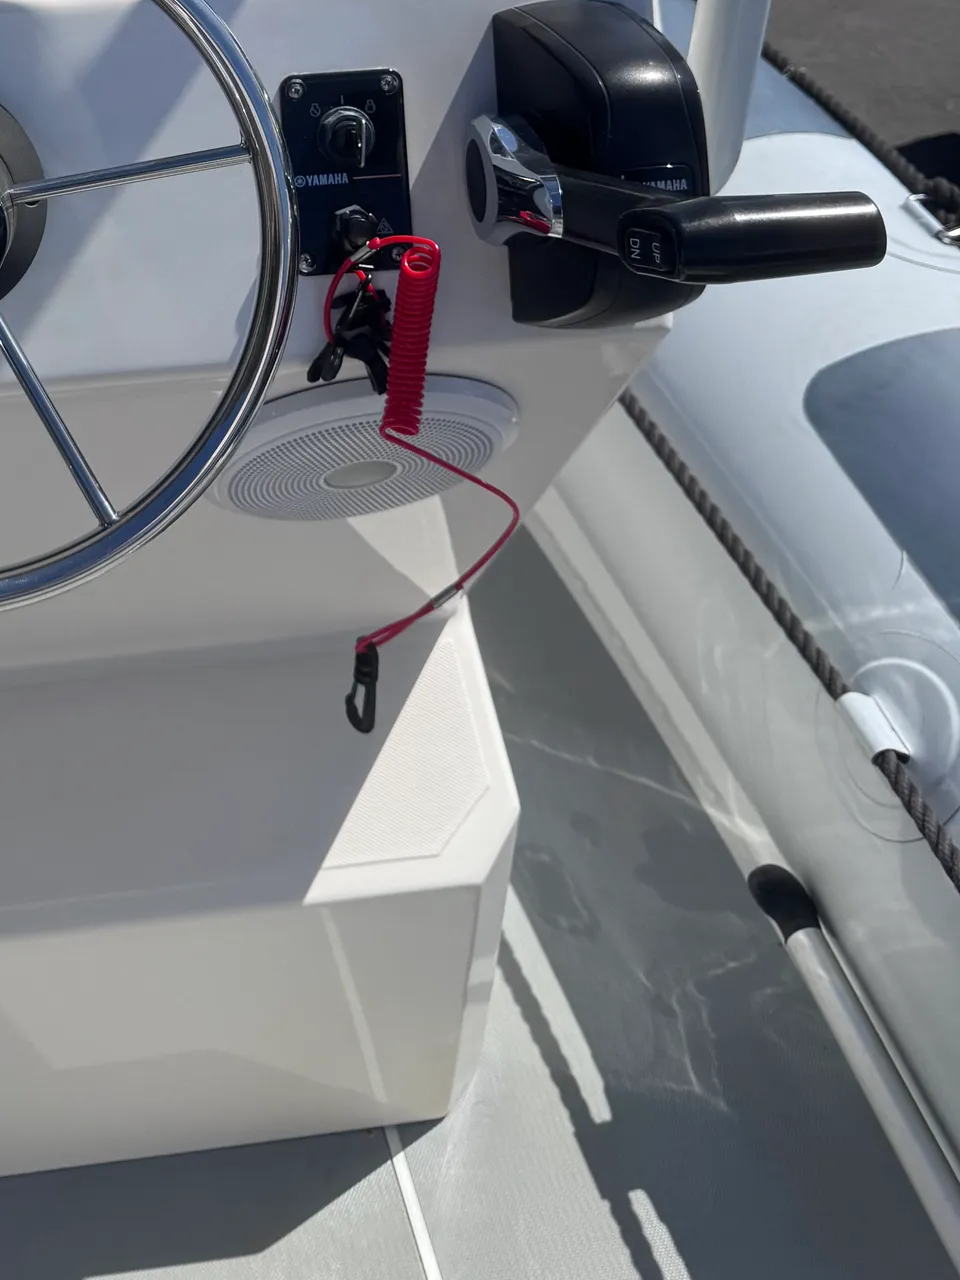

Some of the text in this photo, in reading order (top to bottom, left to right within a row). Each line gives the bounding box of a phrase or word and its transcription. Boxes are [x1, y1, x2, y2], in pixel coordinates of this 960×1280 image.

[305, 172, 349, 187] YAMAHA
[629, 237, 641, 259] DN
[651, 242, 661, 264] UP
